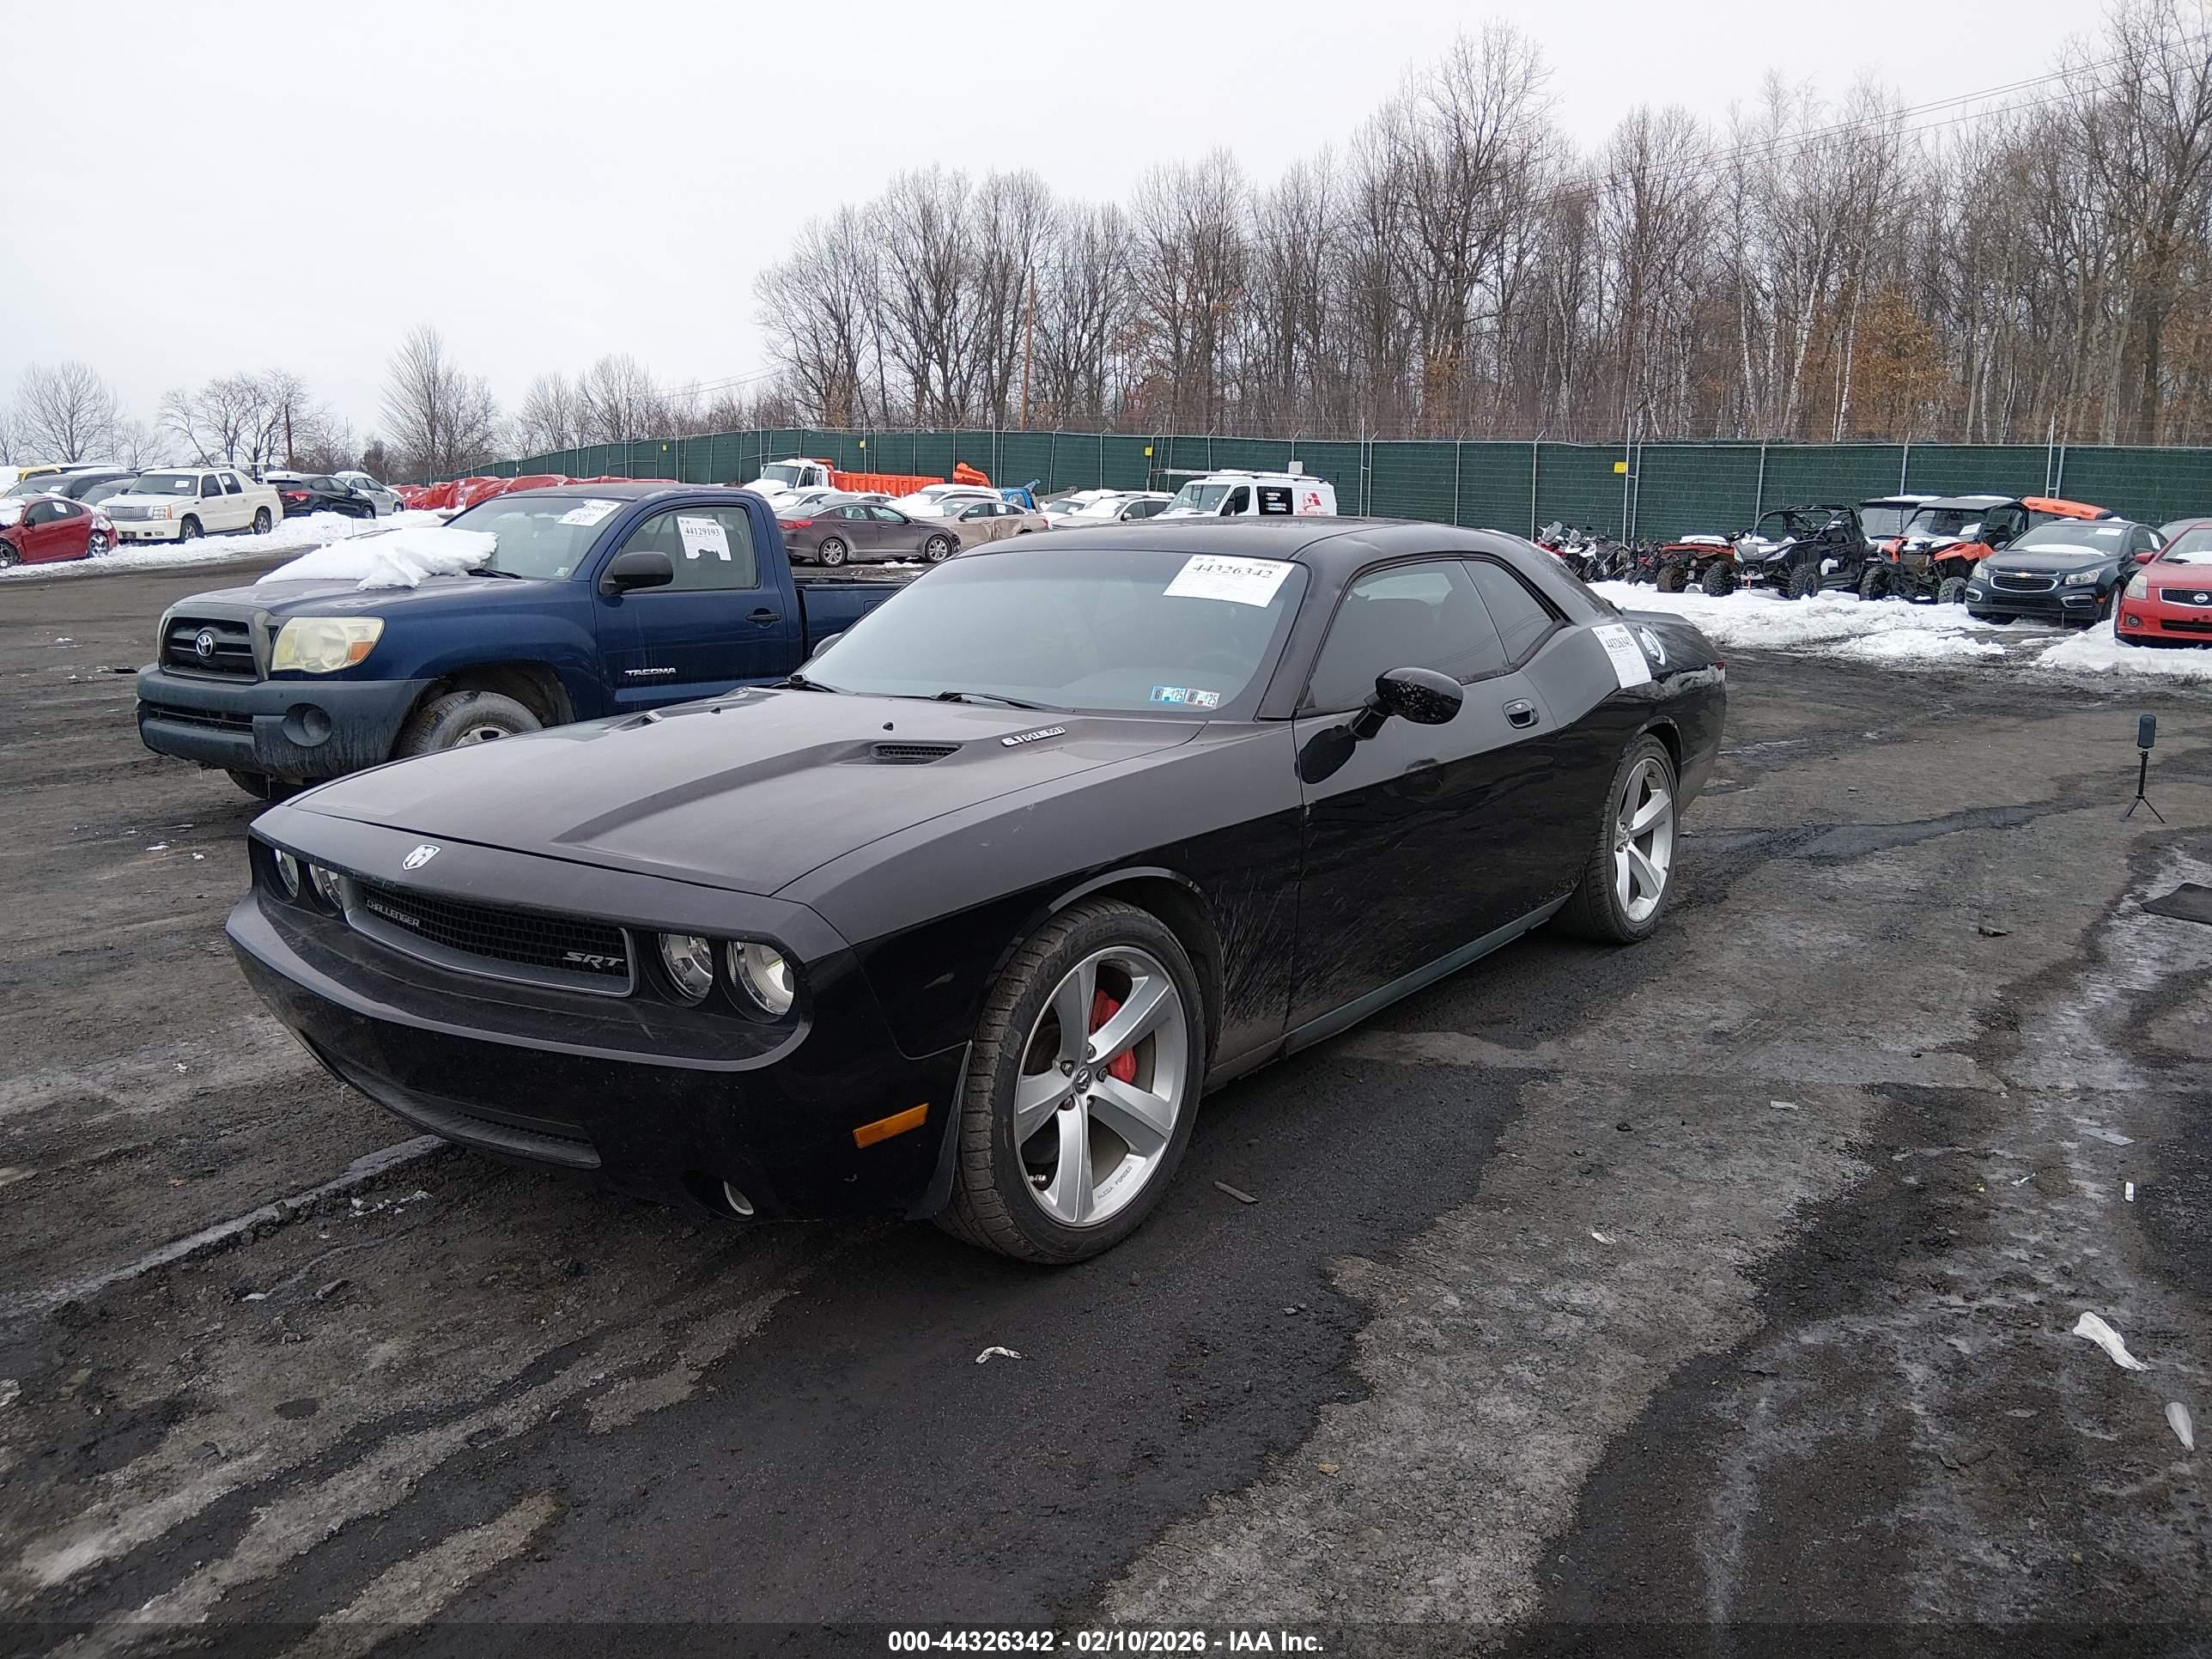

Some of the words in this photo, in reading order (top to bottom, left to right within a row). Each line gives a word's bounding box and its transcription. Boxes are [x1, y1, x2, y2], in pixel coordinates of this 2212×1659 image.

[685, 526, 720, 537] 44129193
[1193, 563, 1273, 579] 44326342
[624, 667, 677, 677] TACOMA
[1021, 726, 1066, 742] HEMI
[367, 899, 419, 927] CHALLENGER
[562, 951, 625, 969] SRT
